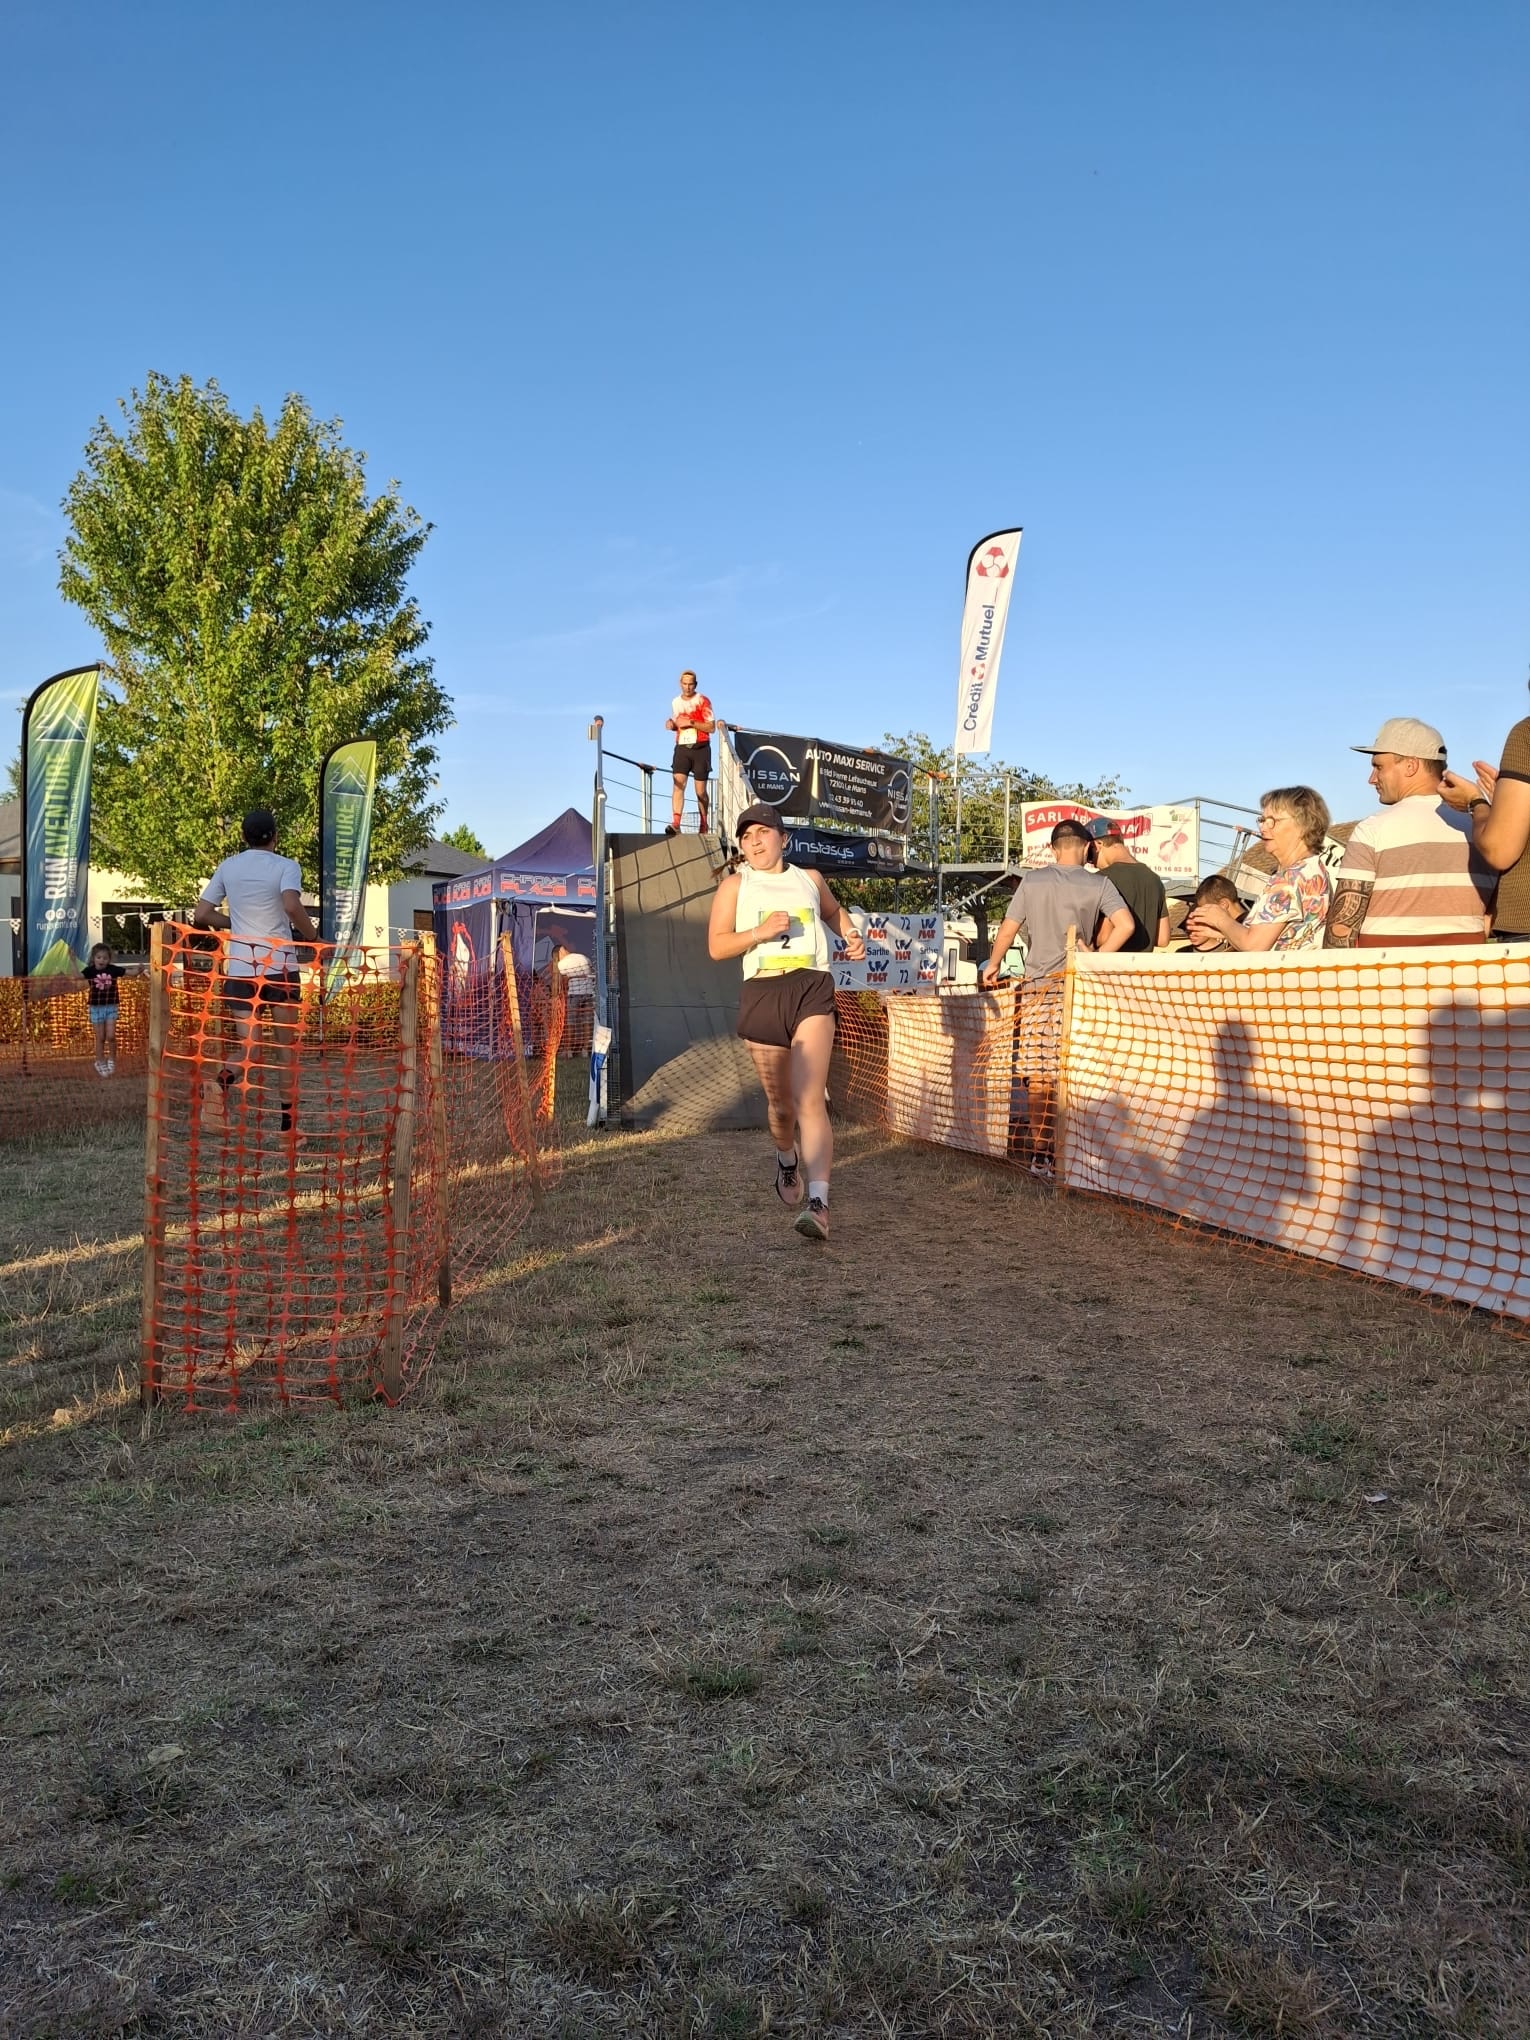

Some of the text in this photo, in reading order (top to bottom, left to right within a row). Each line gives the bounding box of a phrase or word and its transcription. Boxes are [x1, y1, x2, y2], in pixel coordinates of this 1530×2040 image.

[963, 603, 995, 731] Crédit Mutuel
[805, 748, 885, 775] AUTO MAXI SERVICE
[766, 783, 785, 791] MANS
[887, 788, 909, 804] NISSA
[1027, 811, 1064, 825] SARL
[795, 838, 855, 859] Instasys
[900, 916, 911, 931] 72
[780, 934, 791, 949] 2
[866, 946, 890, 956] Sarthe
[839, 970, 852, 986] 72
[899, 969, 909, 984] 72
